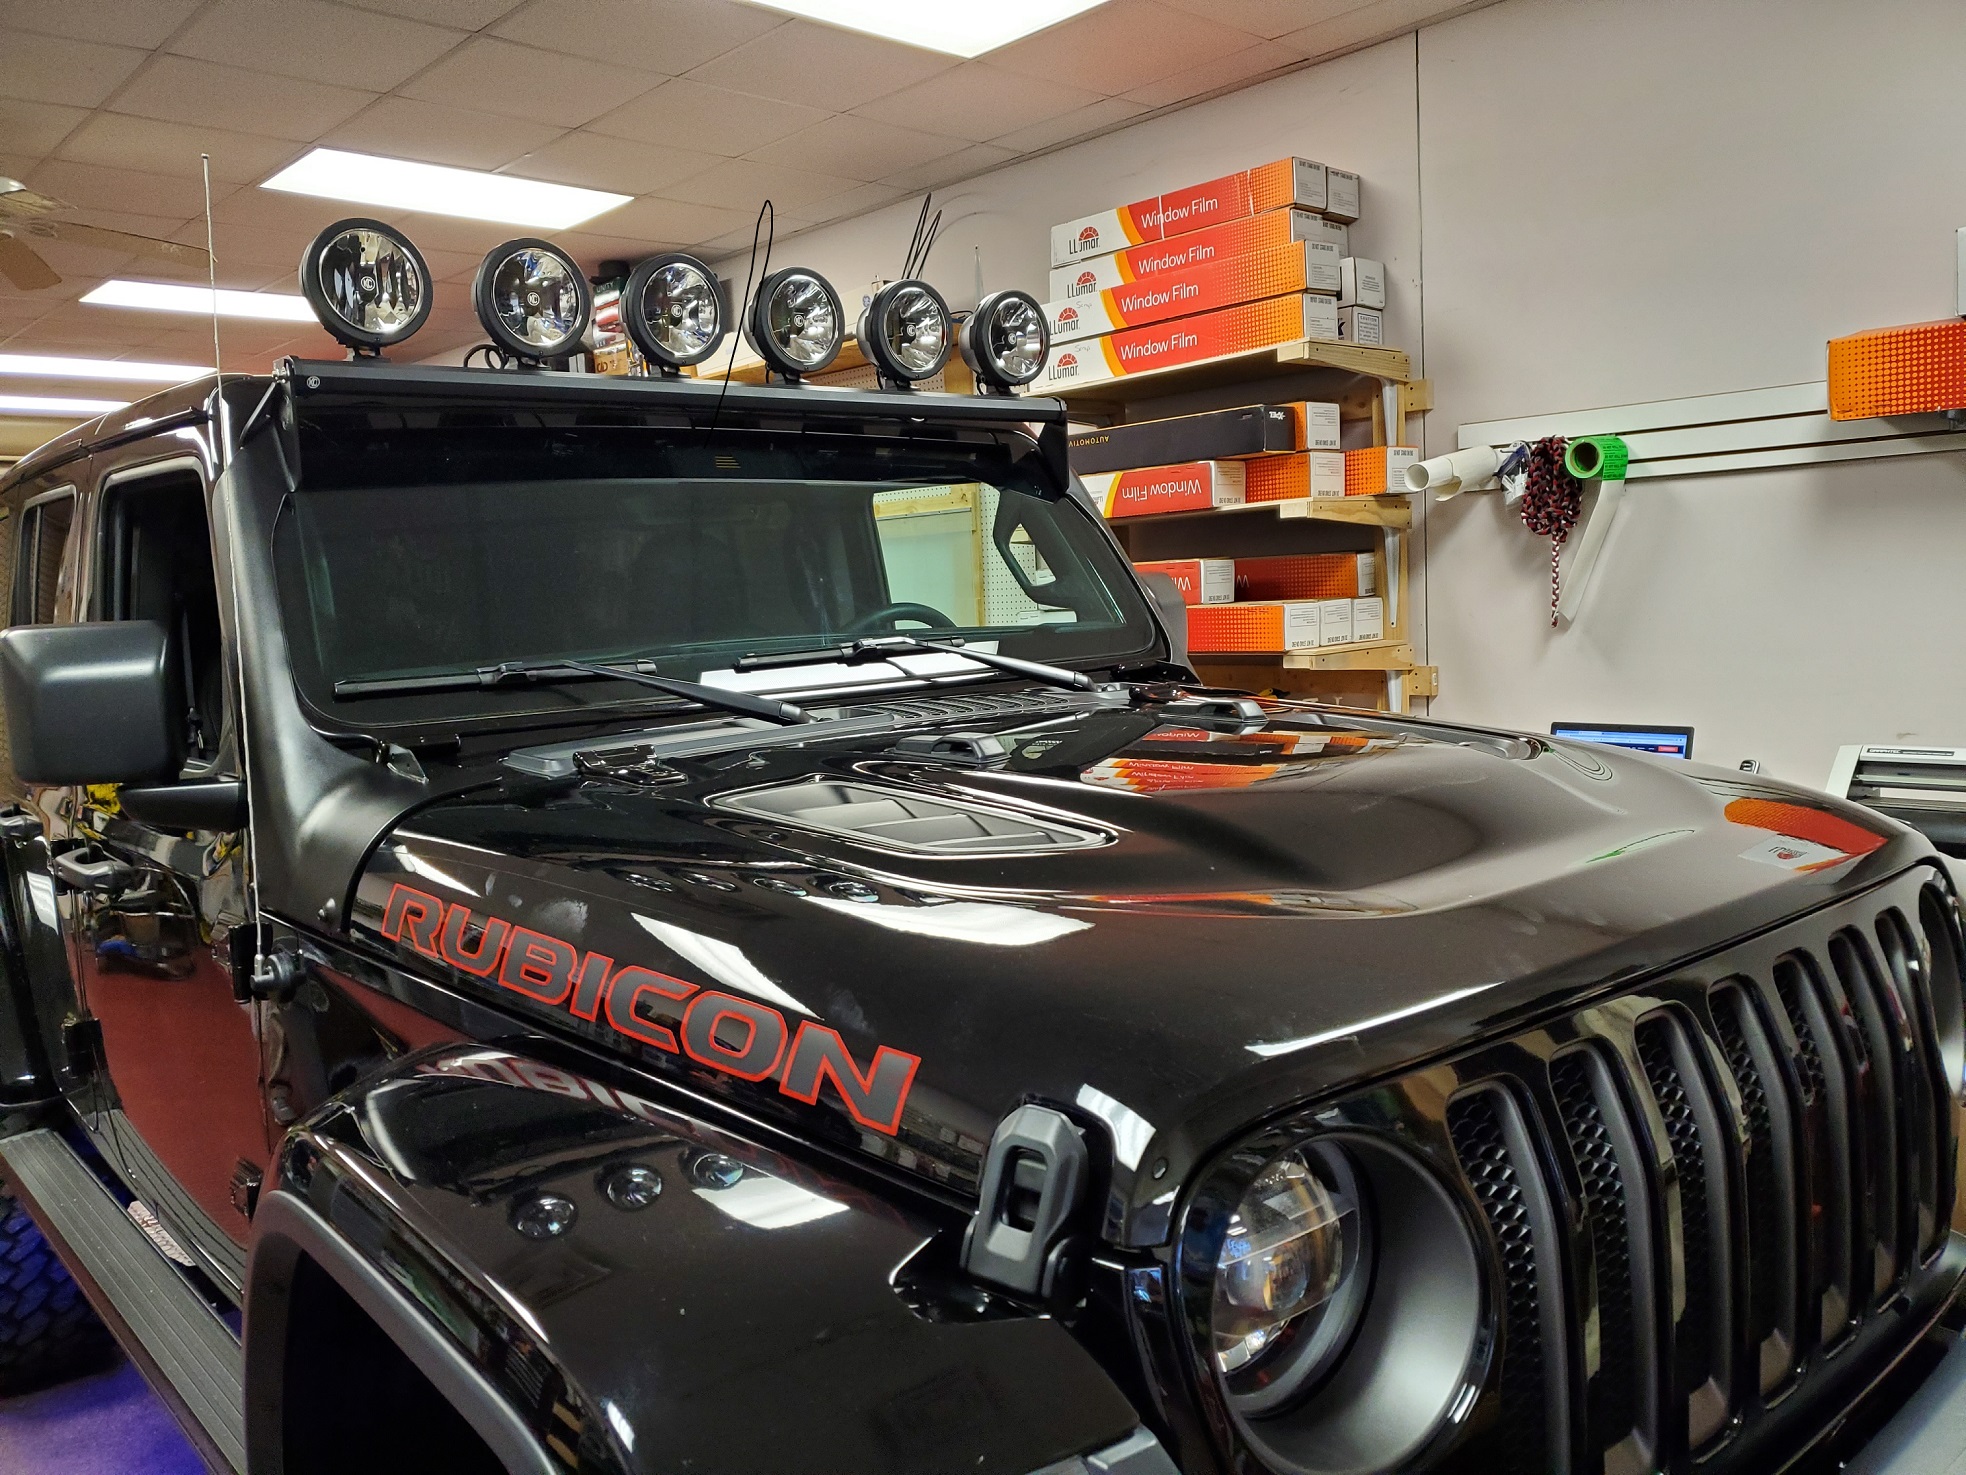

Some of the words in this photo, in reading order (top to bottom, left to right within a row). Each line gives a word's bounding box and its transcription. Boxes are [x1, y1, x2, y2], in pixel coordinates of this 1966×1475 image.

[1141, 206, 1190, 229] Window
[1191, 196, 1218, 215] Film
[1069, 237, 1100, 255] LLumar
[1138, 252, 1187, 274] Window
[1188, 244, 1215, 262] Film
[1067, 282, 1097, 299] LLumar
[1121, 290, 1170, 313] Window
[1172, 282, 1199, 301] Film
[1049, 319, 1080, 336] LLumar
[1120, 338, 1169, 361] Window
[1171, 332, 1198, 351] Film
[1048, 365, 1079, 381] LLumar
[1068, 435, 1109, 448] AUTOMOTIV
[1122, 485, 1148, 502] Film
[1150, 479, 1202, 498] Window
[381, 882, 921, 1137] RUBICON
